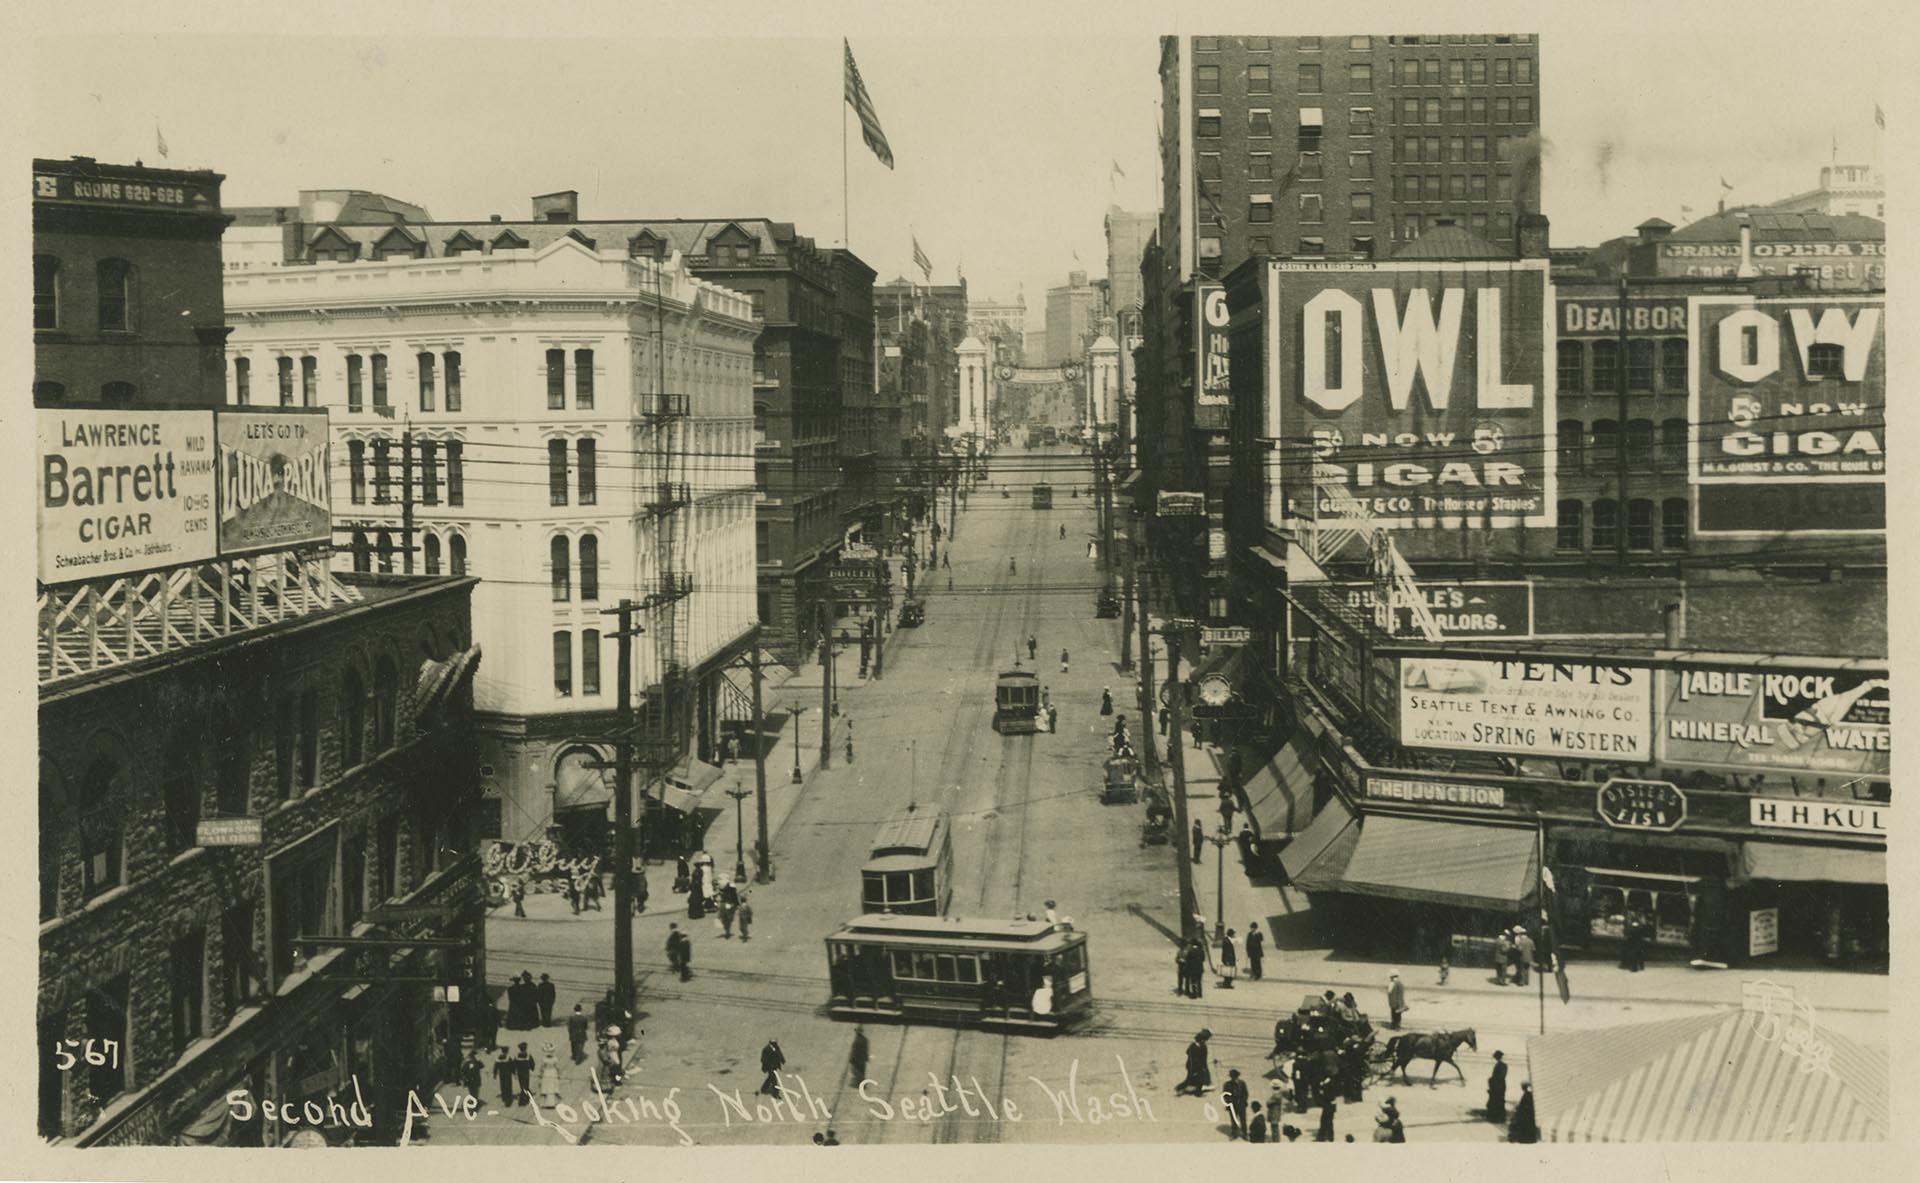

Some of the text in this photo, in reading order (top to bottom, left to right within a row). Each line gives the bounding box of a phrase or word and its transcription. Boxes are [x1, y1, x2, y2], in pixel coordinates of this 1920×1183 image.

[74, 181, 184, 204] ROOMS 620-626
[1754, 244, 1852, 257] OPERA
[1304, 287, 1534, 411] OWL
[1780, 402, 1869, 417] NOW
[62, 420, 162, 448] LAWRENCE
[277, 424, 291, 439] GO
[1361, 432, 1456, 448] NOW
[185, 436, 205, 452] MILD
[43, 450, 177, 509] Barrett
[220, 442, 329, 523] LUNA PARK
[1319, 497, 1370, 513] GUT
[1374, 497, 1385, 512] &
[1388, 497, 1414, 512] CO.
[79, 512, 153, 543] CIGAR
[184, 517, 208, 533] CENTS
[56, 552, 102, 568] Schwabacher
[1493, 660, 1633, 686] TENTS
[1765, 673, 1836, 706] ROCK
[1410, 695, 1473, 713] SEATTLE
[1481, 699, 1519, 716] TENT
[1525, 702, 1537, 716] &
[1544, 703, 1606, 721] AWNING
[1414, 722, 1638, 753] LOCATION SPRING WESTERN
[1670, 720, 1776, 749] MINERAL
[1412, 783, 1503, 807] JUNCTION
[1606, 784, 1678, 806] OYSTERS
